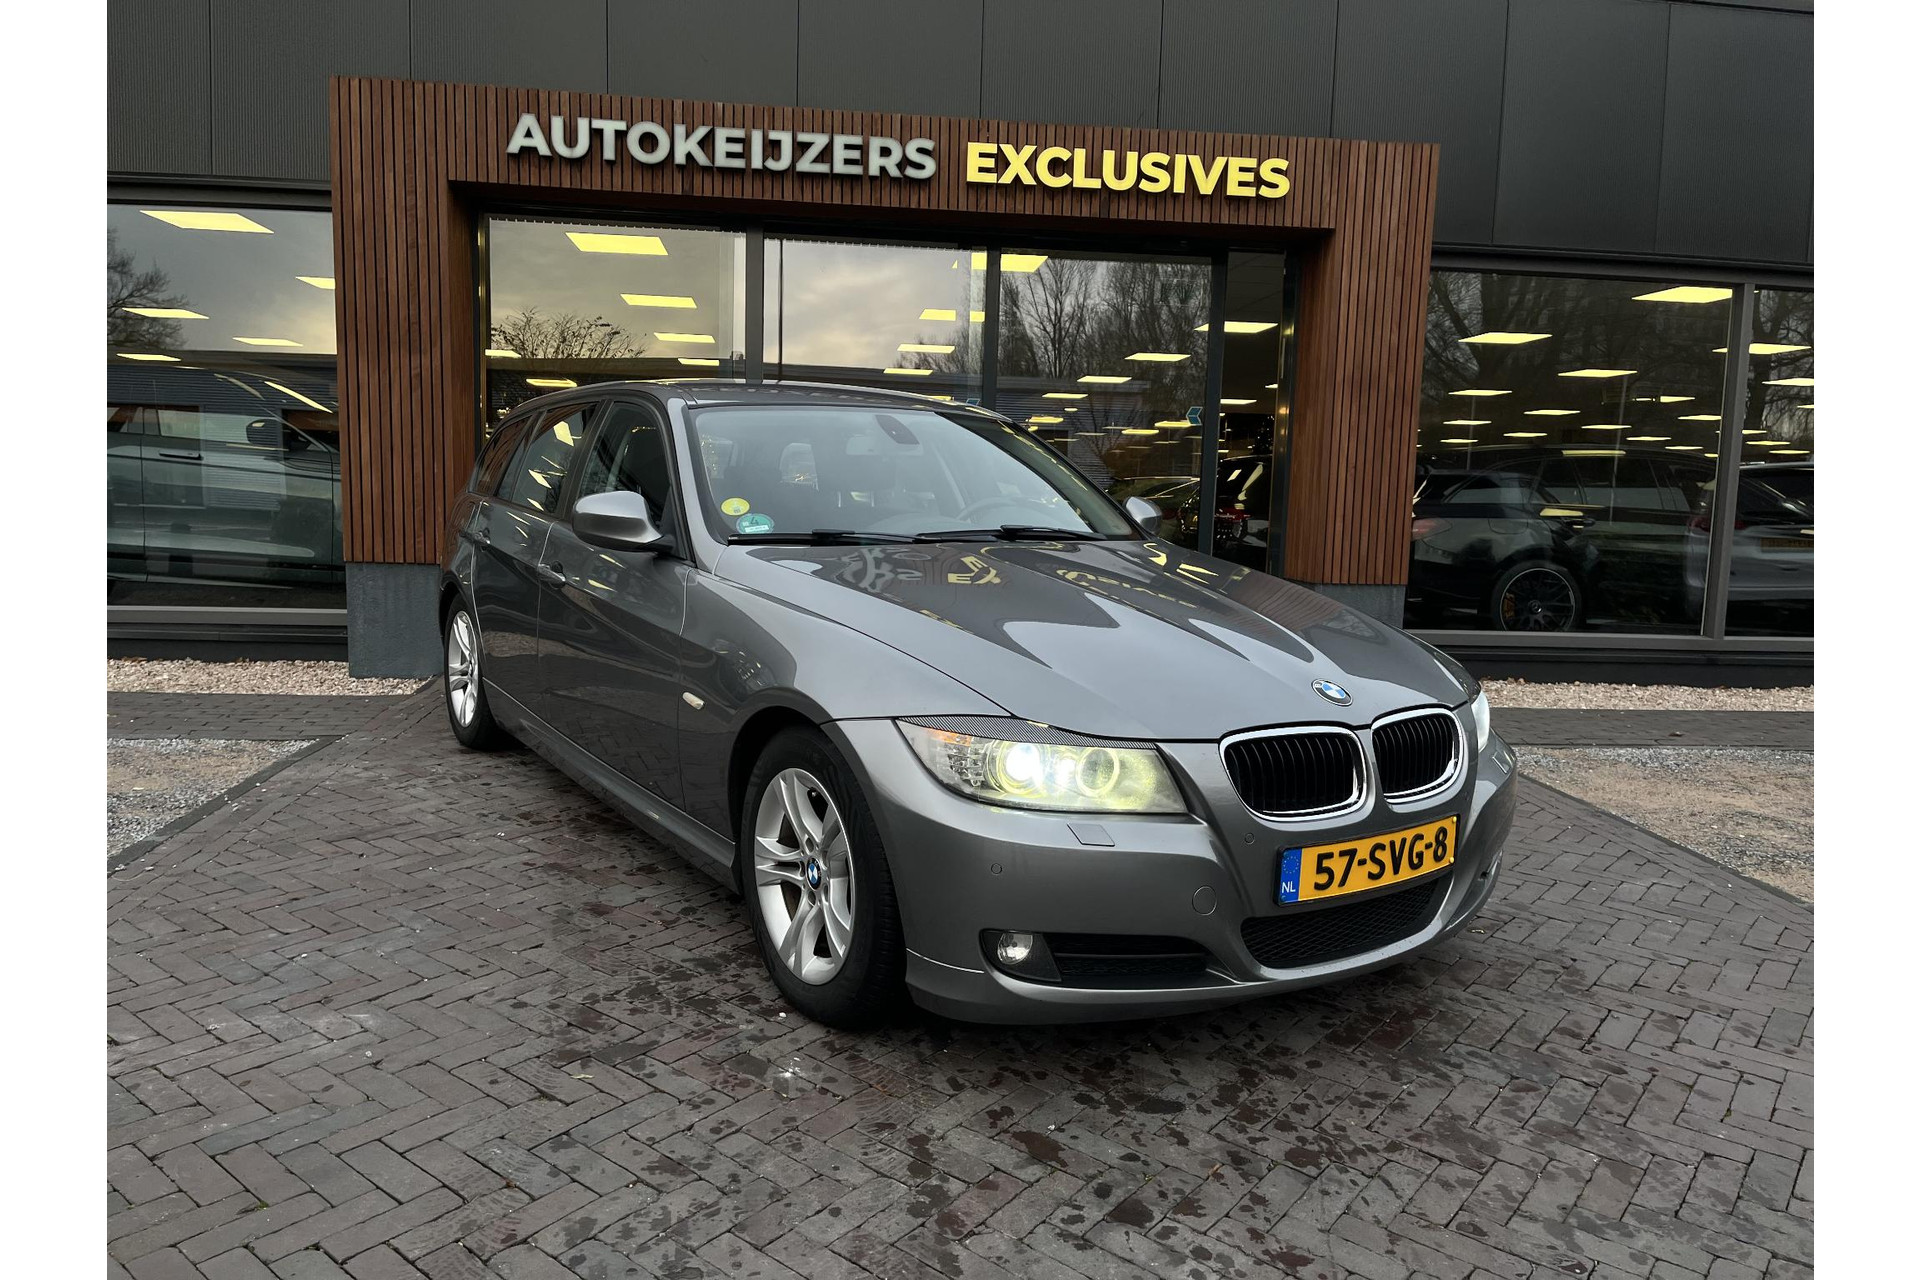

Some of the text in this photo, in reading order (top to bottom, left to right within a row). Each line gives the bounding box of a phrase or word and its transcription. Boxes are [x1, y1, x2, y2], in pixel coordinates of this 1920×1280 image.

[506, 113, 1291, 199] AUTOKEIJZERS EXCLUSIVES
[1281, 881, 1296, 893] NL
[1313, 826, 1448, 891] 57-SVG-8
